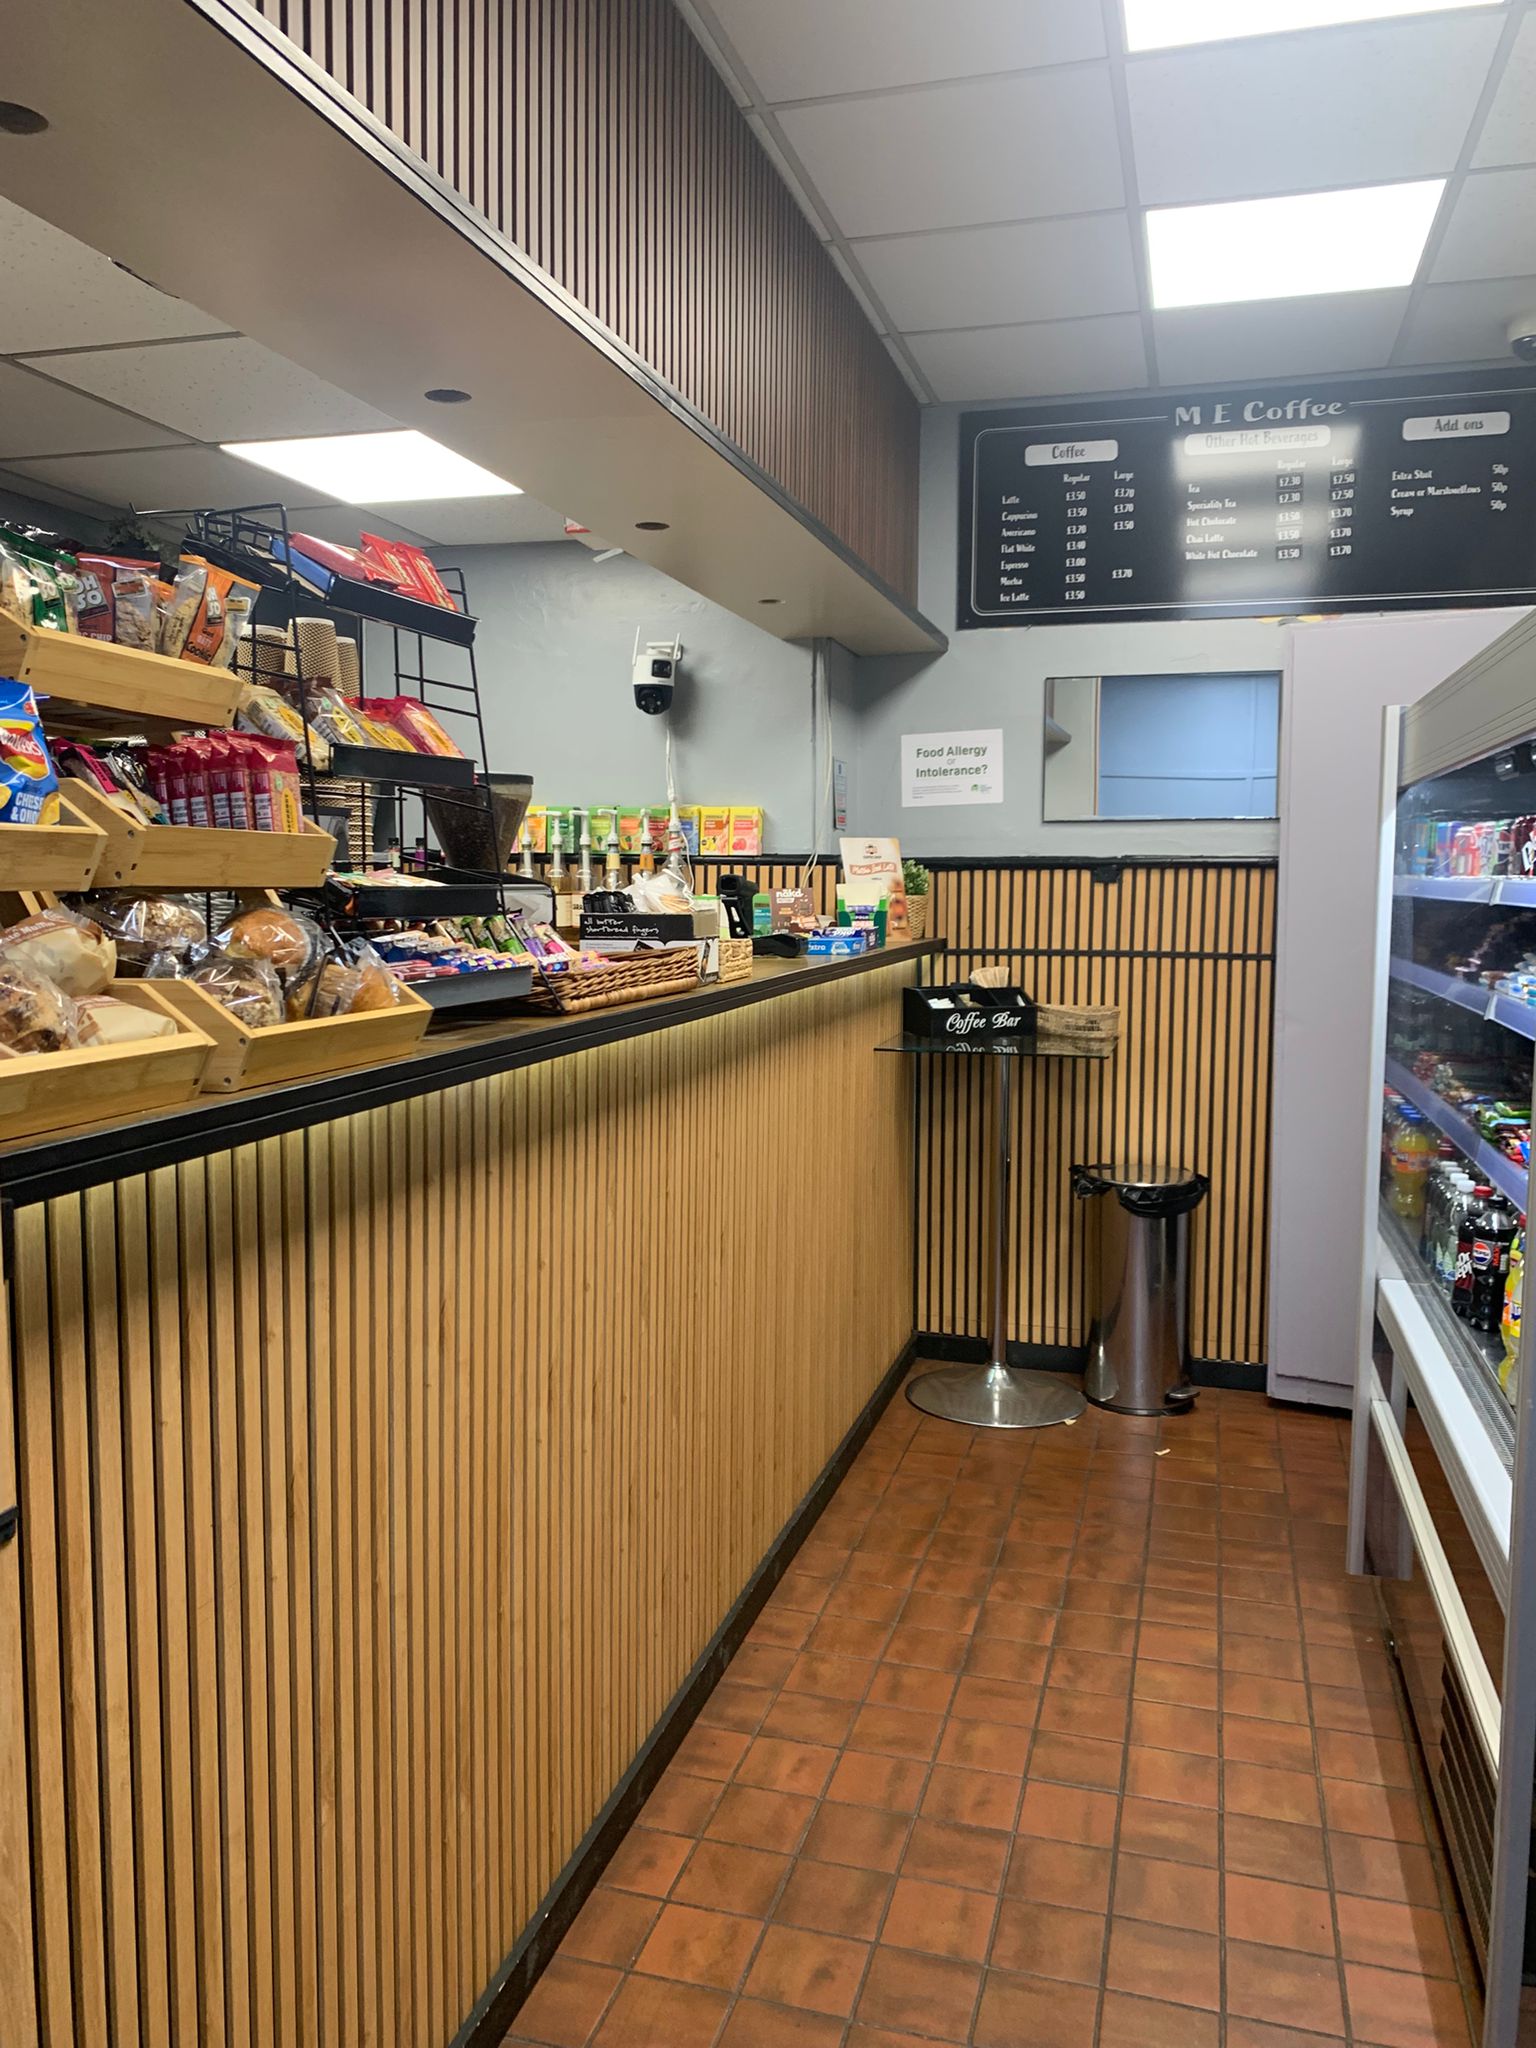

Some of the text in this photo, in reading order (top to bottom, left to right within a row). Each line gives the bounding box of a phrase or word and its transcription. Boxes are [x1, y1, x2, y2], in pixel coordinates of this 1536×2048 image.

[1175, 397, 1347, 427] M E Coffee
[1434, 418, 1484, 432] Add ons
[1205, 430, 1318, 449] Other Hot Beverages
[1052, 445, 1087, 459] Coffee
[1277, 456, 1353, 471] Regular Large
[1063, 470, 1134, 485] Regular Large
[1392, 463, 1509, 481] Extra Shot 50p
[1188, 473, 1355, 493] Tea £2.30 £2.50
[1391, 488, 1415, 499] Cream
[1416, 489, 1425, 497] or
[1491, 481, 1508, 493] 50p
[1002, 488, 1135, 504] Latte £3.50 £3.70
[1224, 498, 1237, 508] Tea
[1279, 492, 1301, 504] £2.30
[1332, 489, 1354, 501] £2.50
[1067, 507, 1088, 517] £3.50
[1113, 503, 1134, 514] £3.70
[1390, 499, 1507, 518] Syrup 50p
[1187, 517, 1200, 527] Hot
[1331, 507, 1353, 519] £3.70
[1001, 527, 1036, 537] Americano
[1113, 520, 1135, 531] £3.50
[1205, 533, 1224, 543] Latte
[1278, 530, 1300, 541] £3.50
[1330, 527, 1352, 538] £3.70
[1001, 544, 1014, 553] Flat
[1016, 543, 1036, 553] White
[1185, 551, 1206, 560] White
[1207, 549, 1220, 559] Hot
[1277, 548, 1300, 560] £3.50
[1330, 545, 1352, 557] £3.70
[1001, 561, 1029, 571] Espresso
[1000, 569, 1133, 586] Mocha £3.50 £3.70
[1000, 590, 1085, 602] Ice Latte £3.50
[916, 746, 988, 758] Food Allergy
[915, 764, 989, 778] Intolerance?
[584, 917, 593, 925] all
[632, 924, 660, 936] fingers
[946, 1010, 1022, 1035] Coffee Bar
